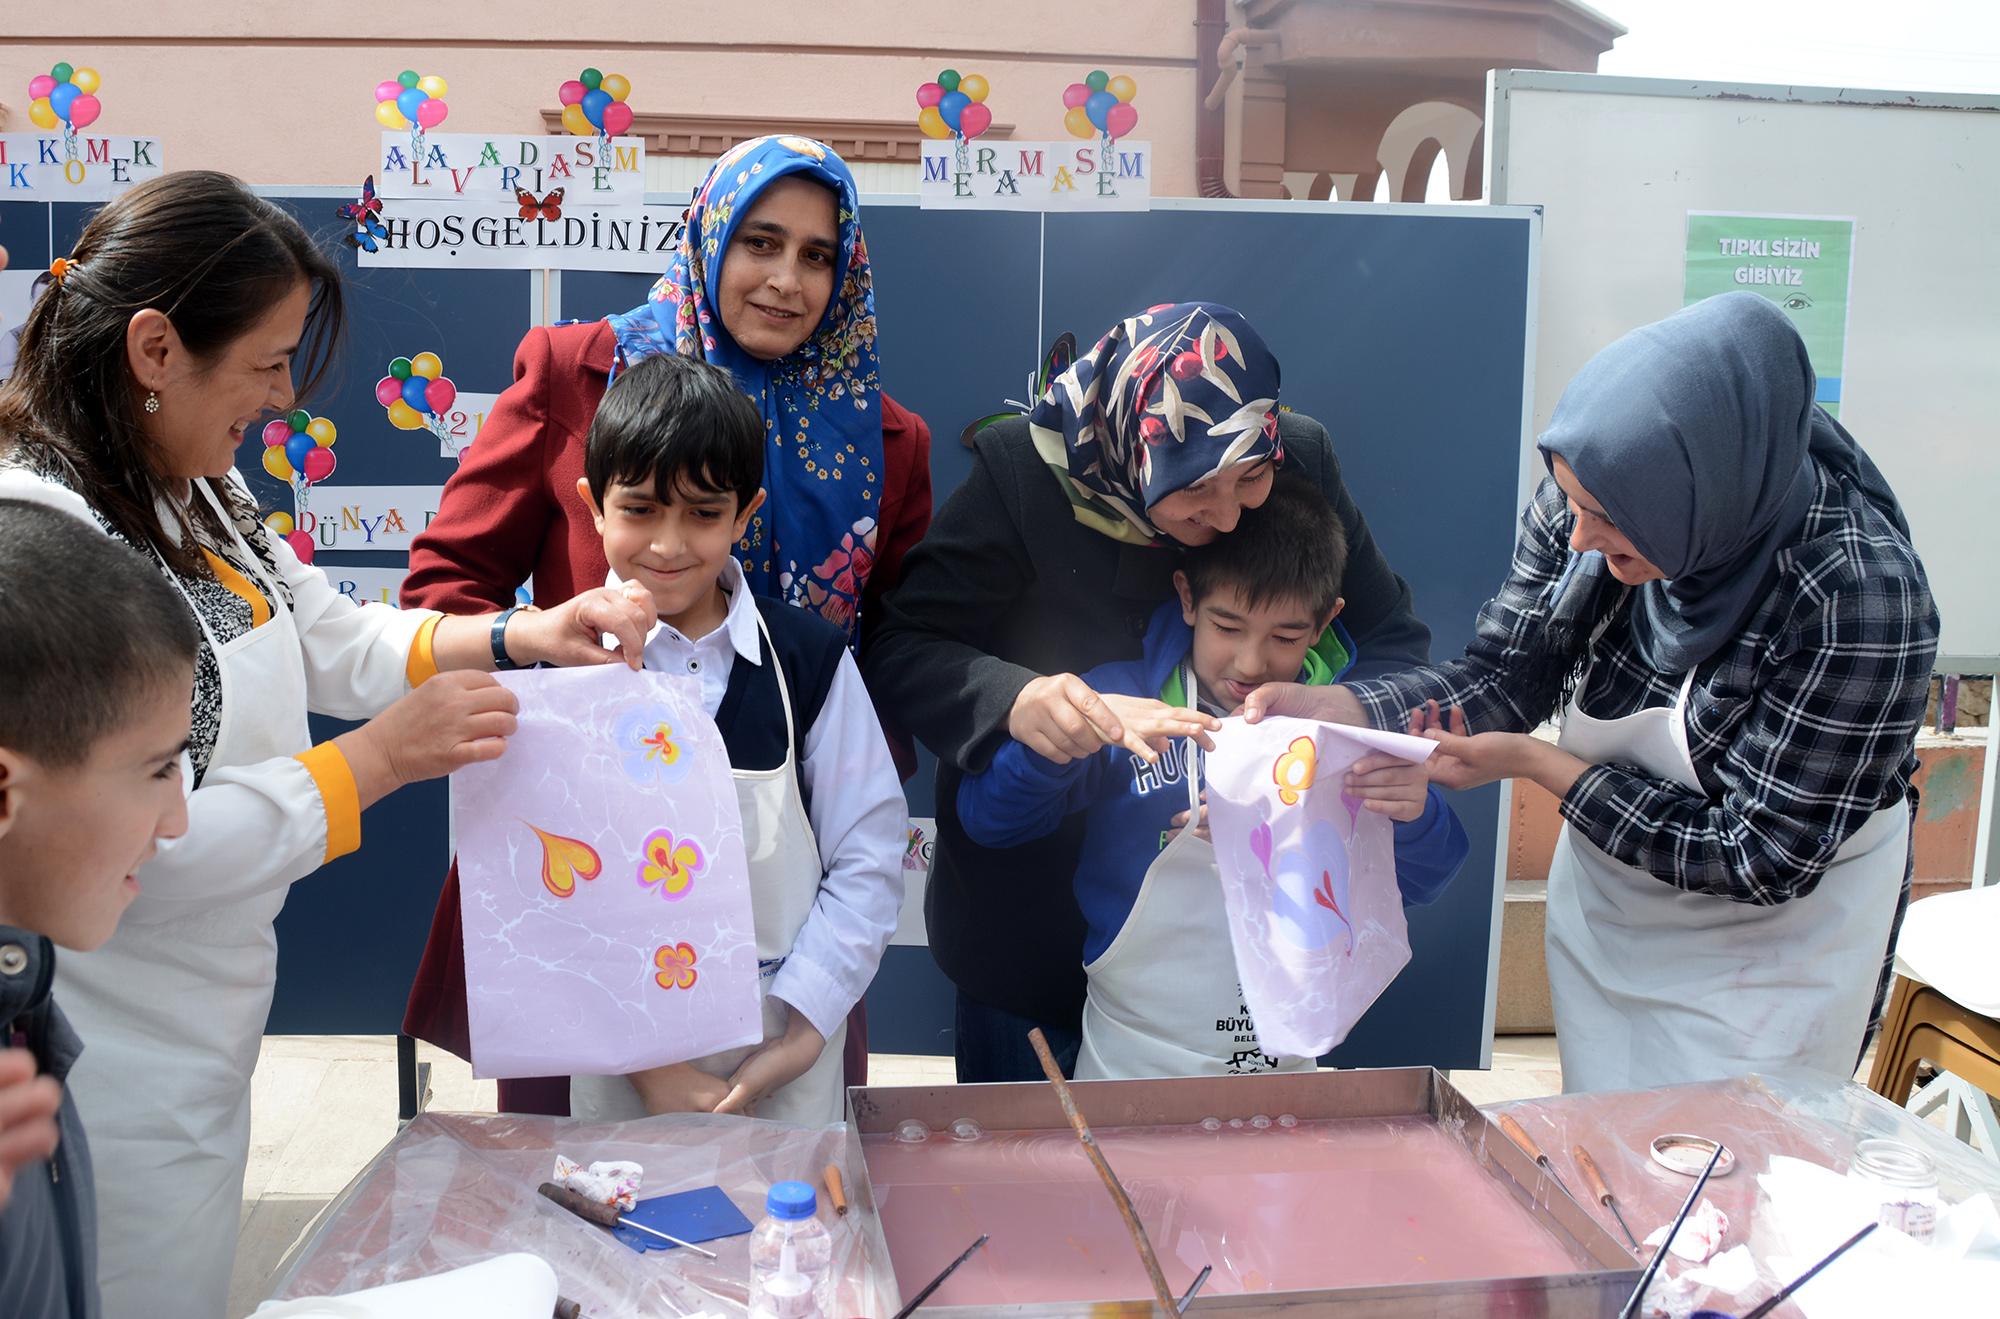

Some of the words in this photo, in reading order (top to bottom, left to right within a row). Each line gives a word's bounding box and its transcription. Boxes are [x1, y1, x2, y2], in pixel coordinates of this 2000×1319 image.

[549, 142, 639, 190] ASEM
[923, 148, 1043, 196] MERAM
[1051, 148, 1144, 196] ASEM
[1719, 238, 1767, 256] TIPKI
[1771, 237, 1820, 258] SİZİN
[1734, 264, 1803, 285] GİBİYİZ
[450, 411, 483, 435] 21
[300, 506, 405, 546] DÜNYA
[1248, 1059, 1265, 1067] KONYA
